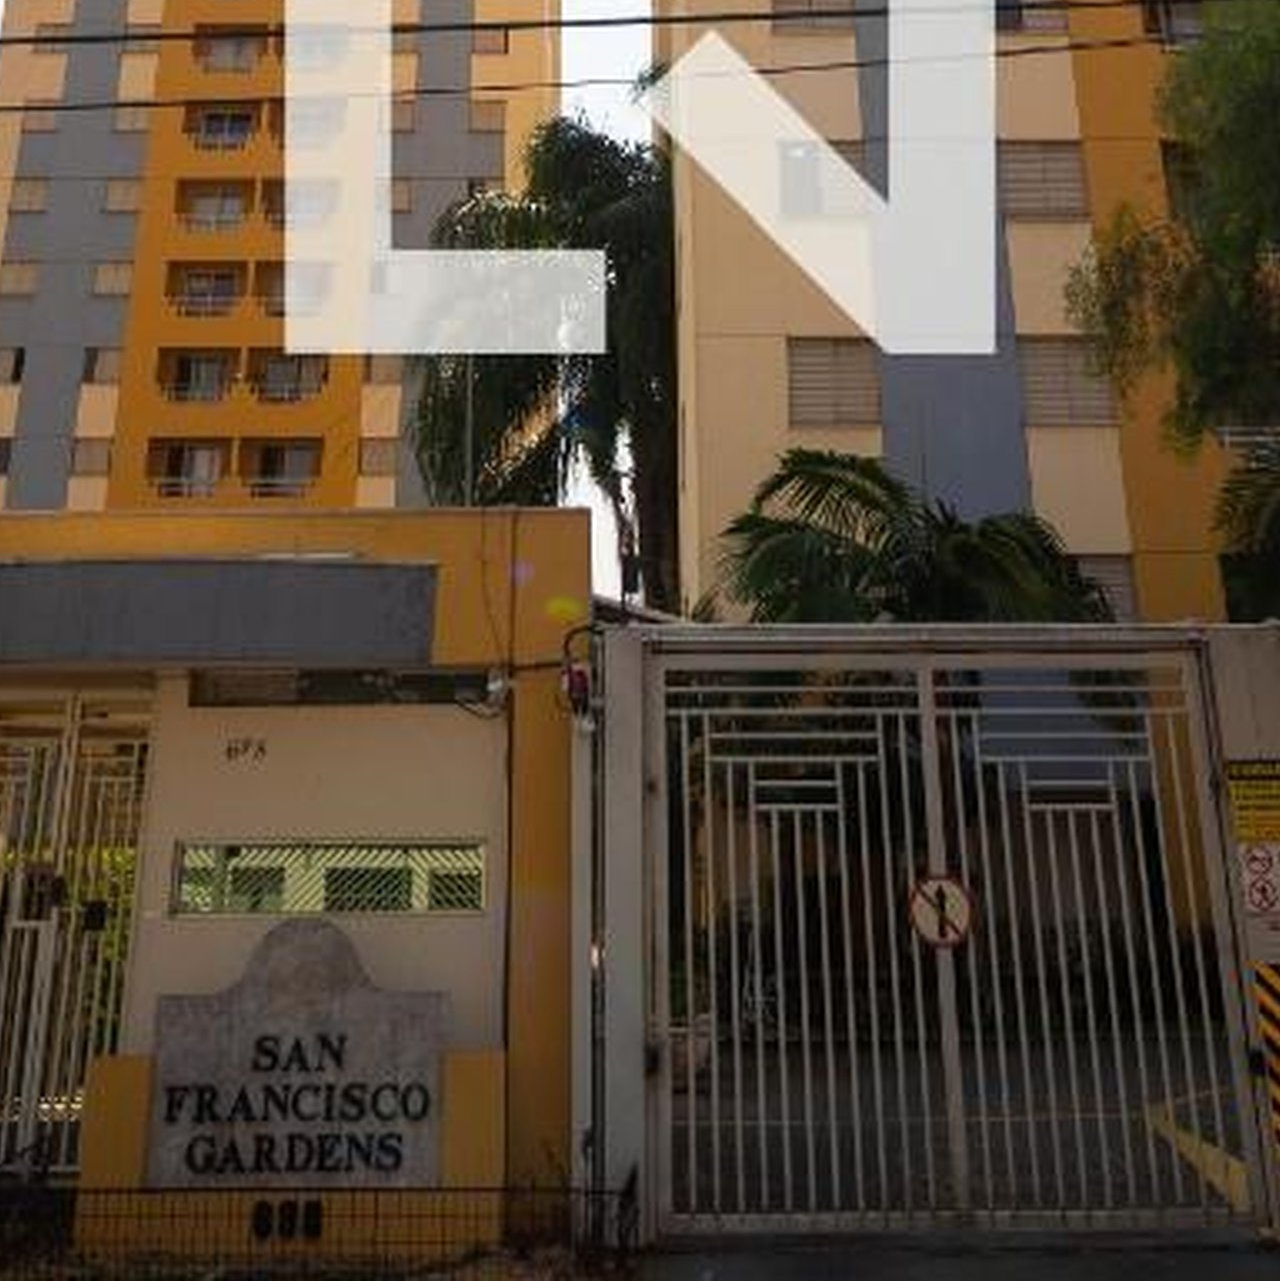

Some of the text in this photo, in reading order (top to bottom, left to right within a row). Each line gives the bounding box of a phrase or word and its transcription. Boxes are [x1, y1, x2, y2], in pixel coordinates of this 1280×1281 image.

[252, 1033, 348, 1073] SAN
[163, 1082, 431, 1124] FRANCISCO
[184, 1132, 404, 1176] GARDENS
